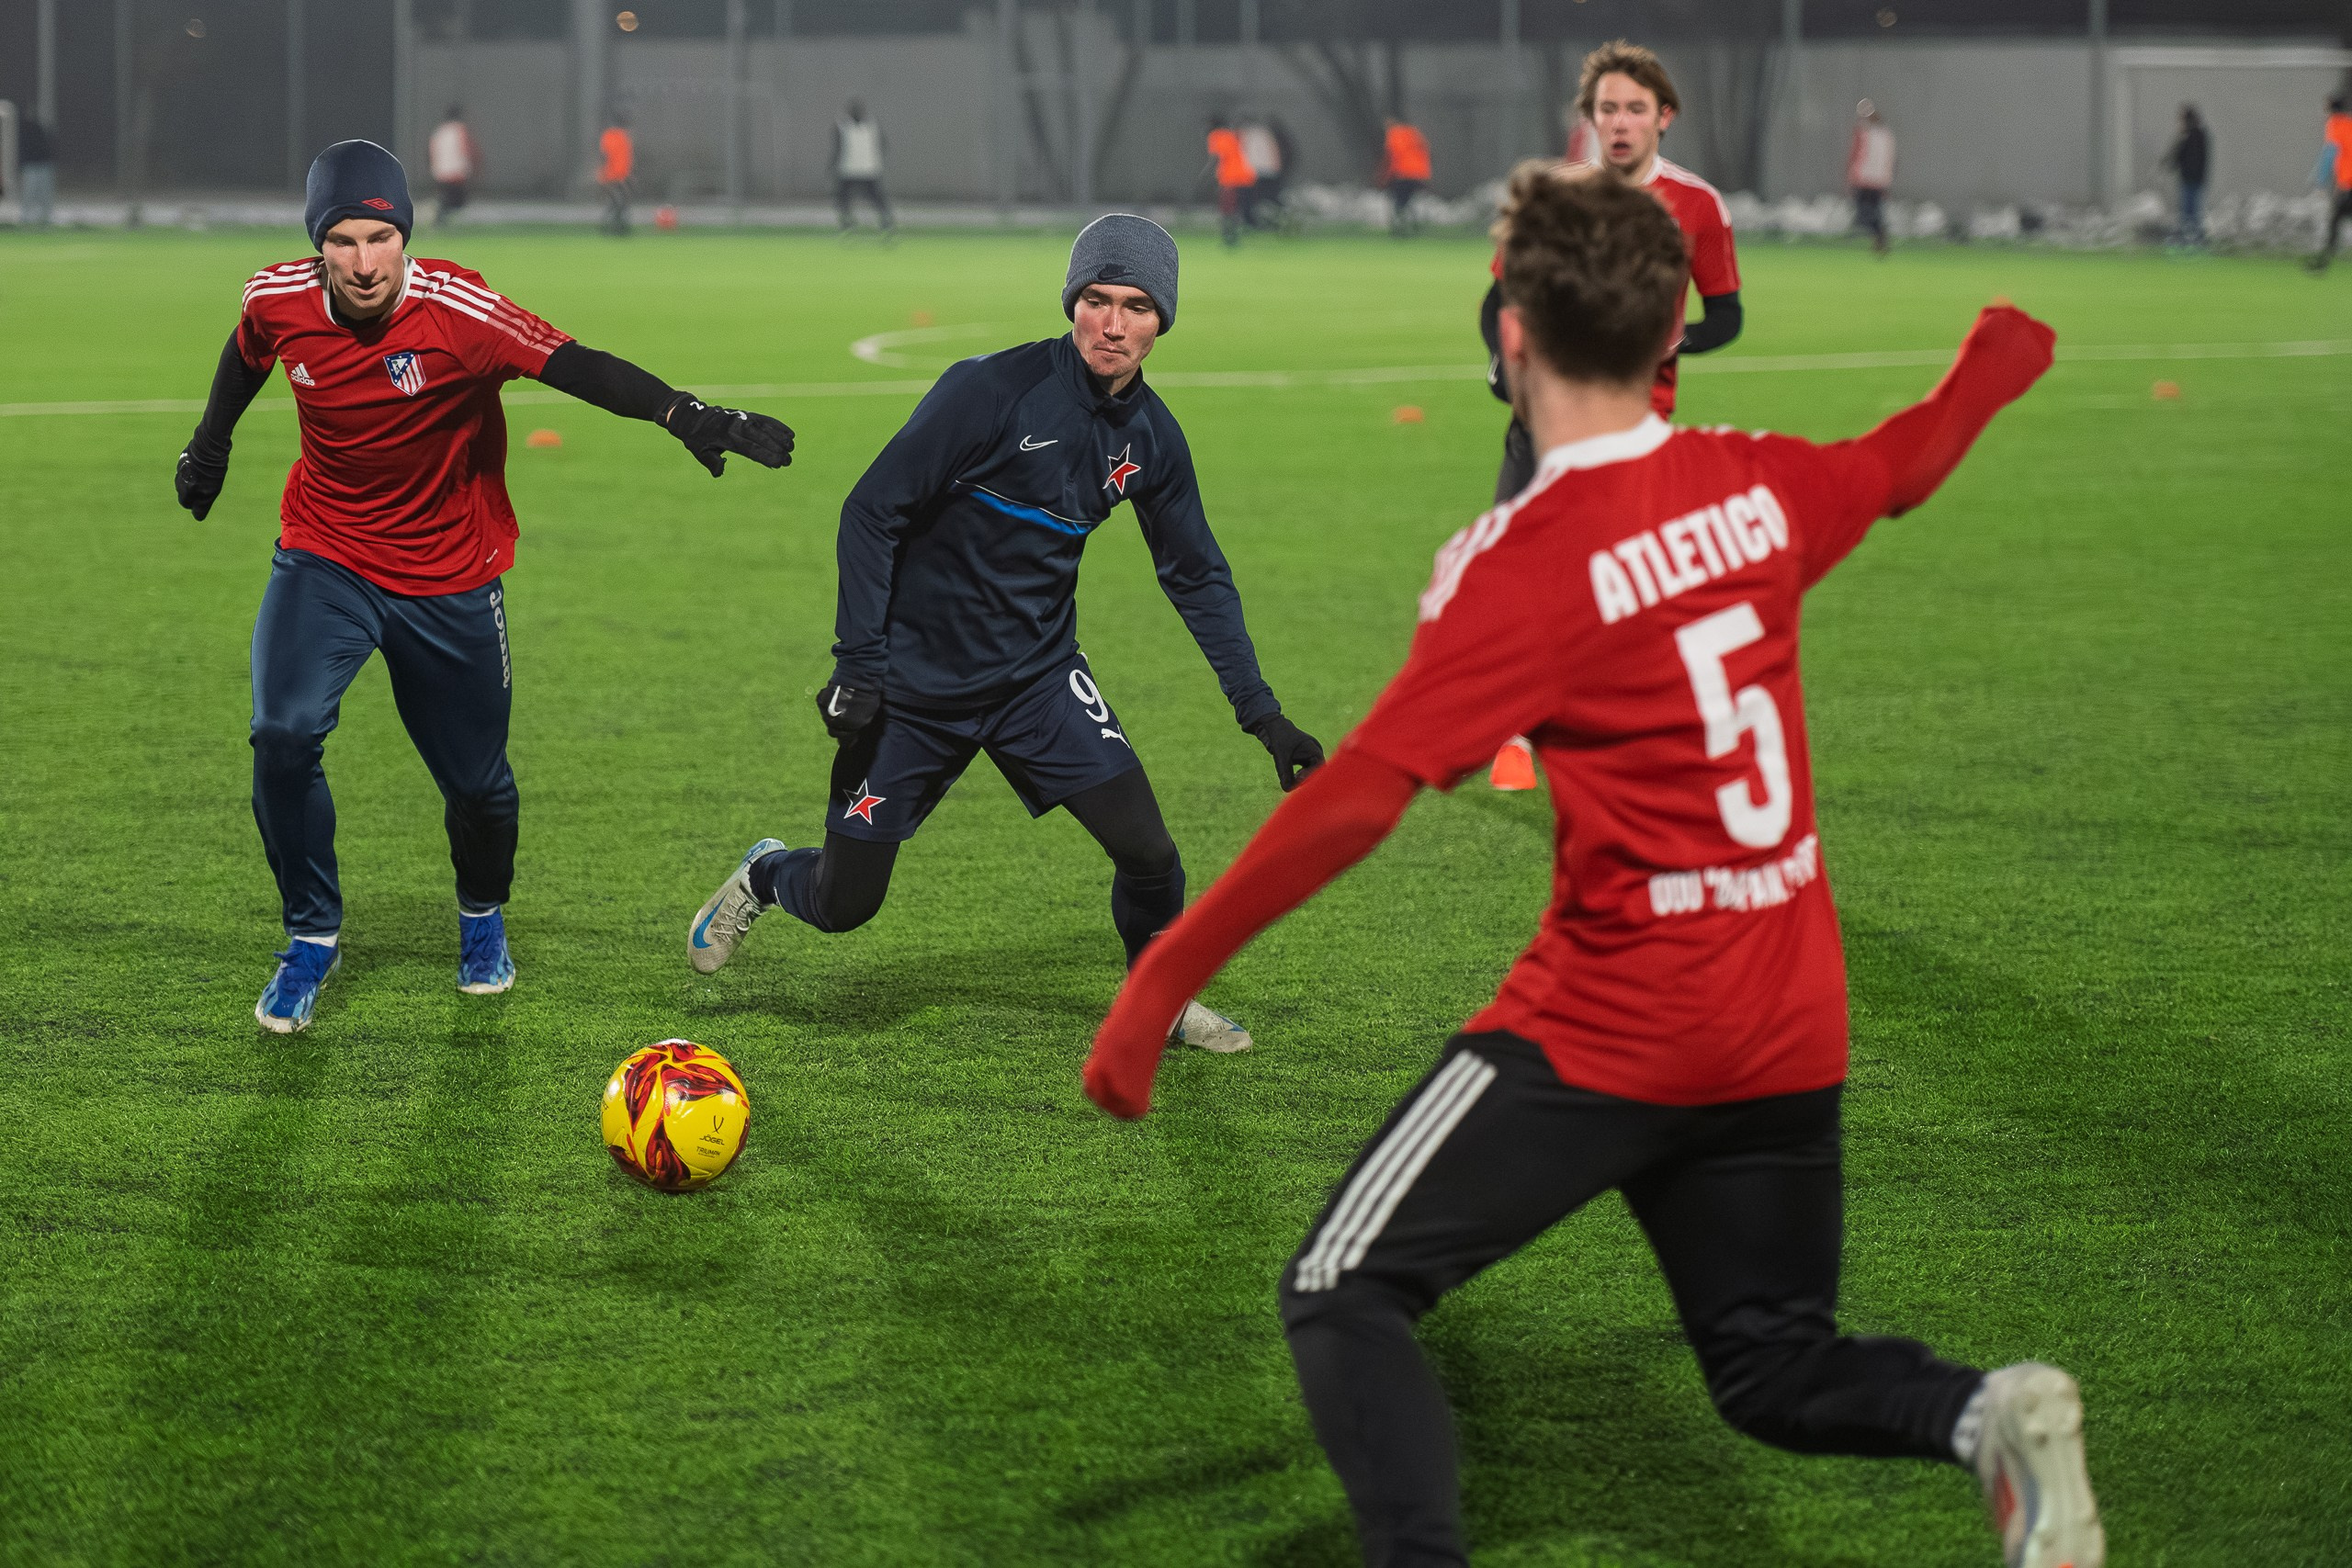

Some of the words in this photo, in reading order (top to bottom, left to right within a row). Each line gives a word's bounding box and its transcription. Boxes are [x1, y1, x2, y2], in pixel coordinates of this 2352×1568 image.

[290, 373, 315, 387] adidas
[1589, 483, 1790, 626] ATLETICO
[1069, 669, 1109, 723] 9
[1673, 601, 1792, 849] 5
